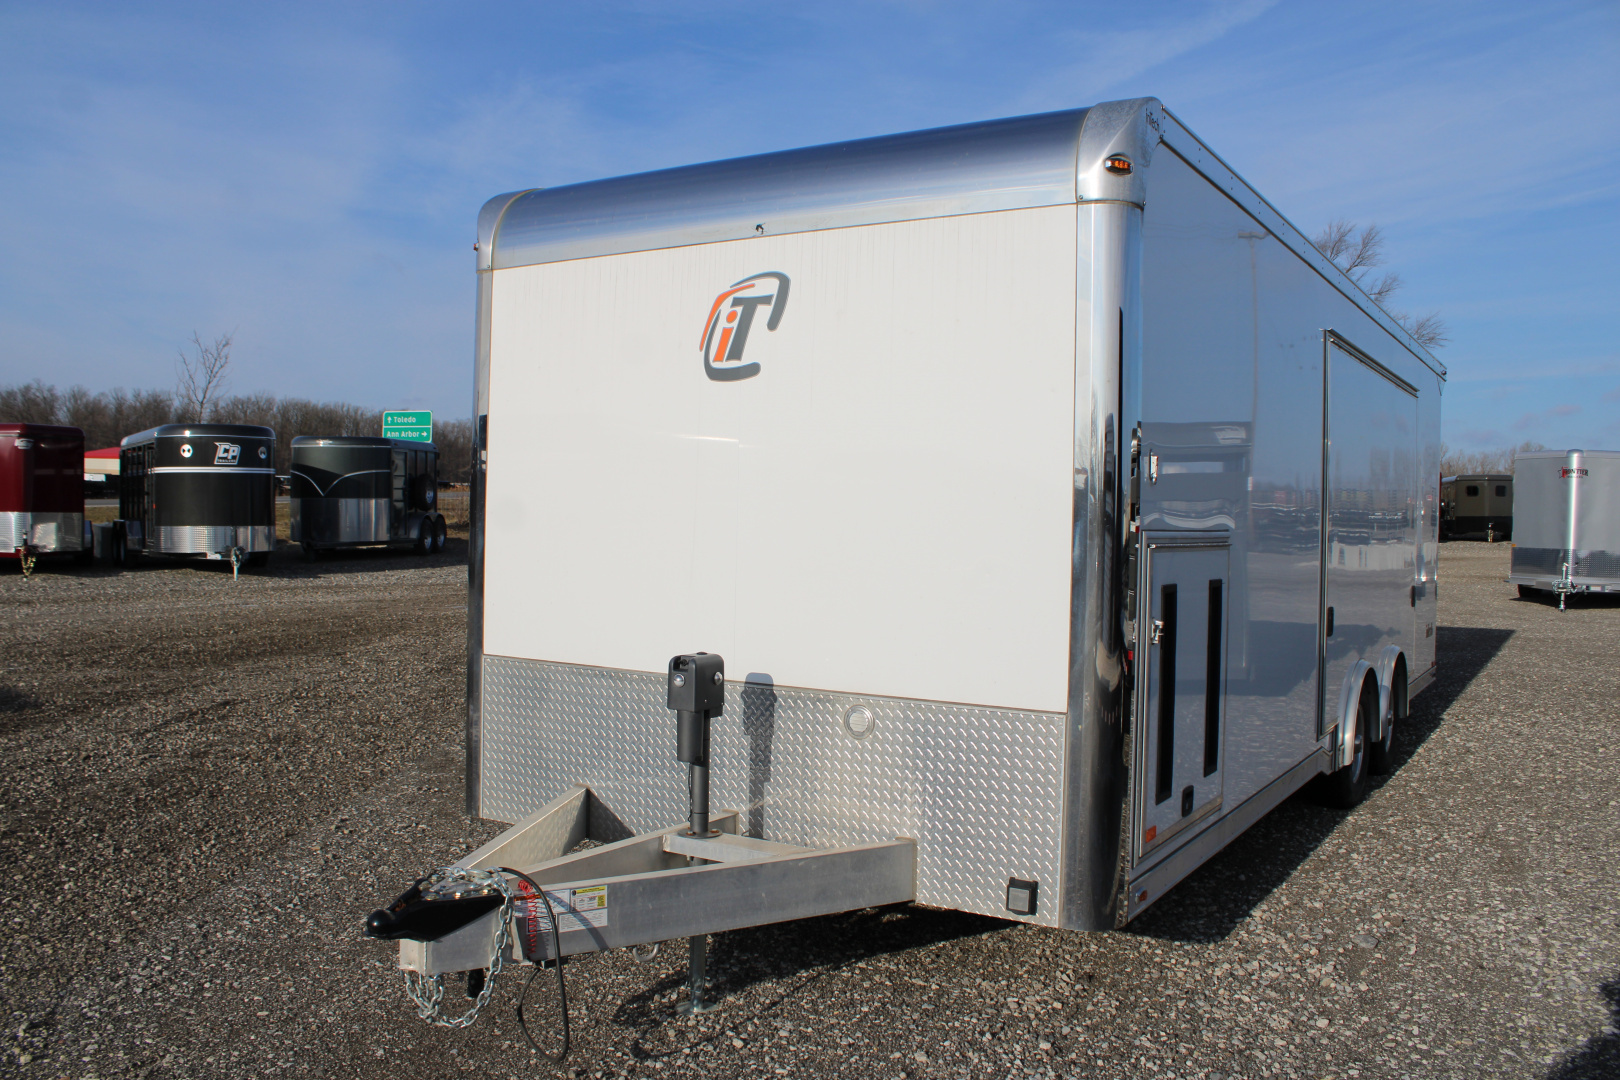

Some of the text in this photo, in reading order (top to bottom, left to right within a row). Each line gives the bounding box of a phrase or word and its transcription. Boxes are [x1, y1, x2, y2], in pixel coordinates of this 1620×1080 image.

[386, 430, 420, 438] Ann Arbor
[218, 444, 239, 460] CP
